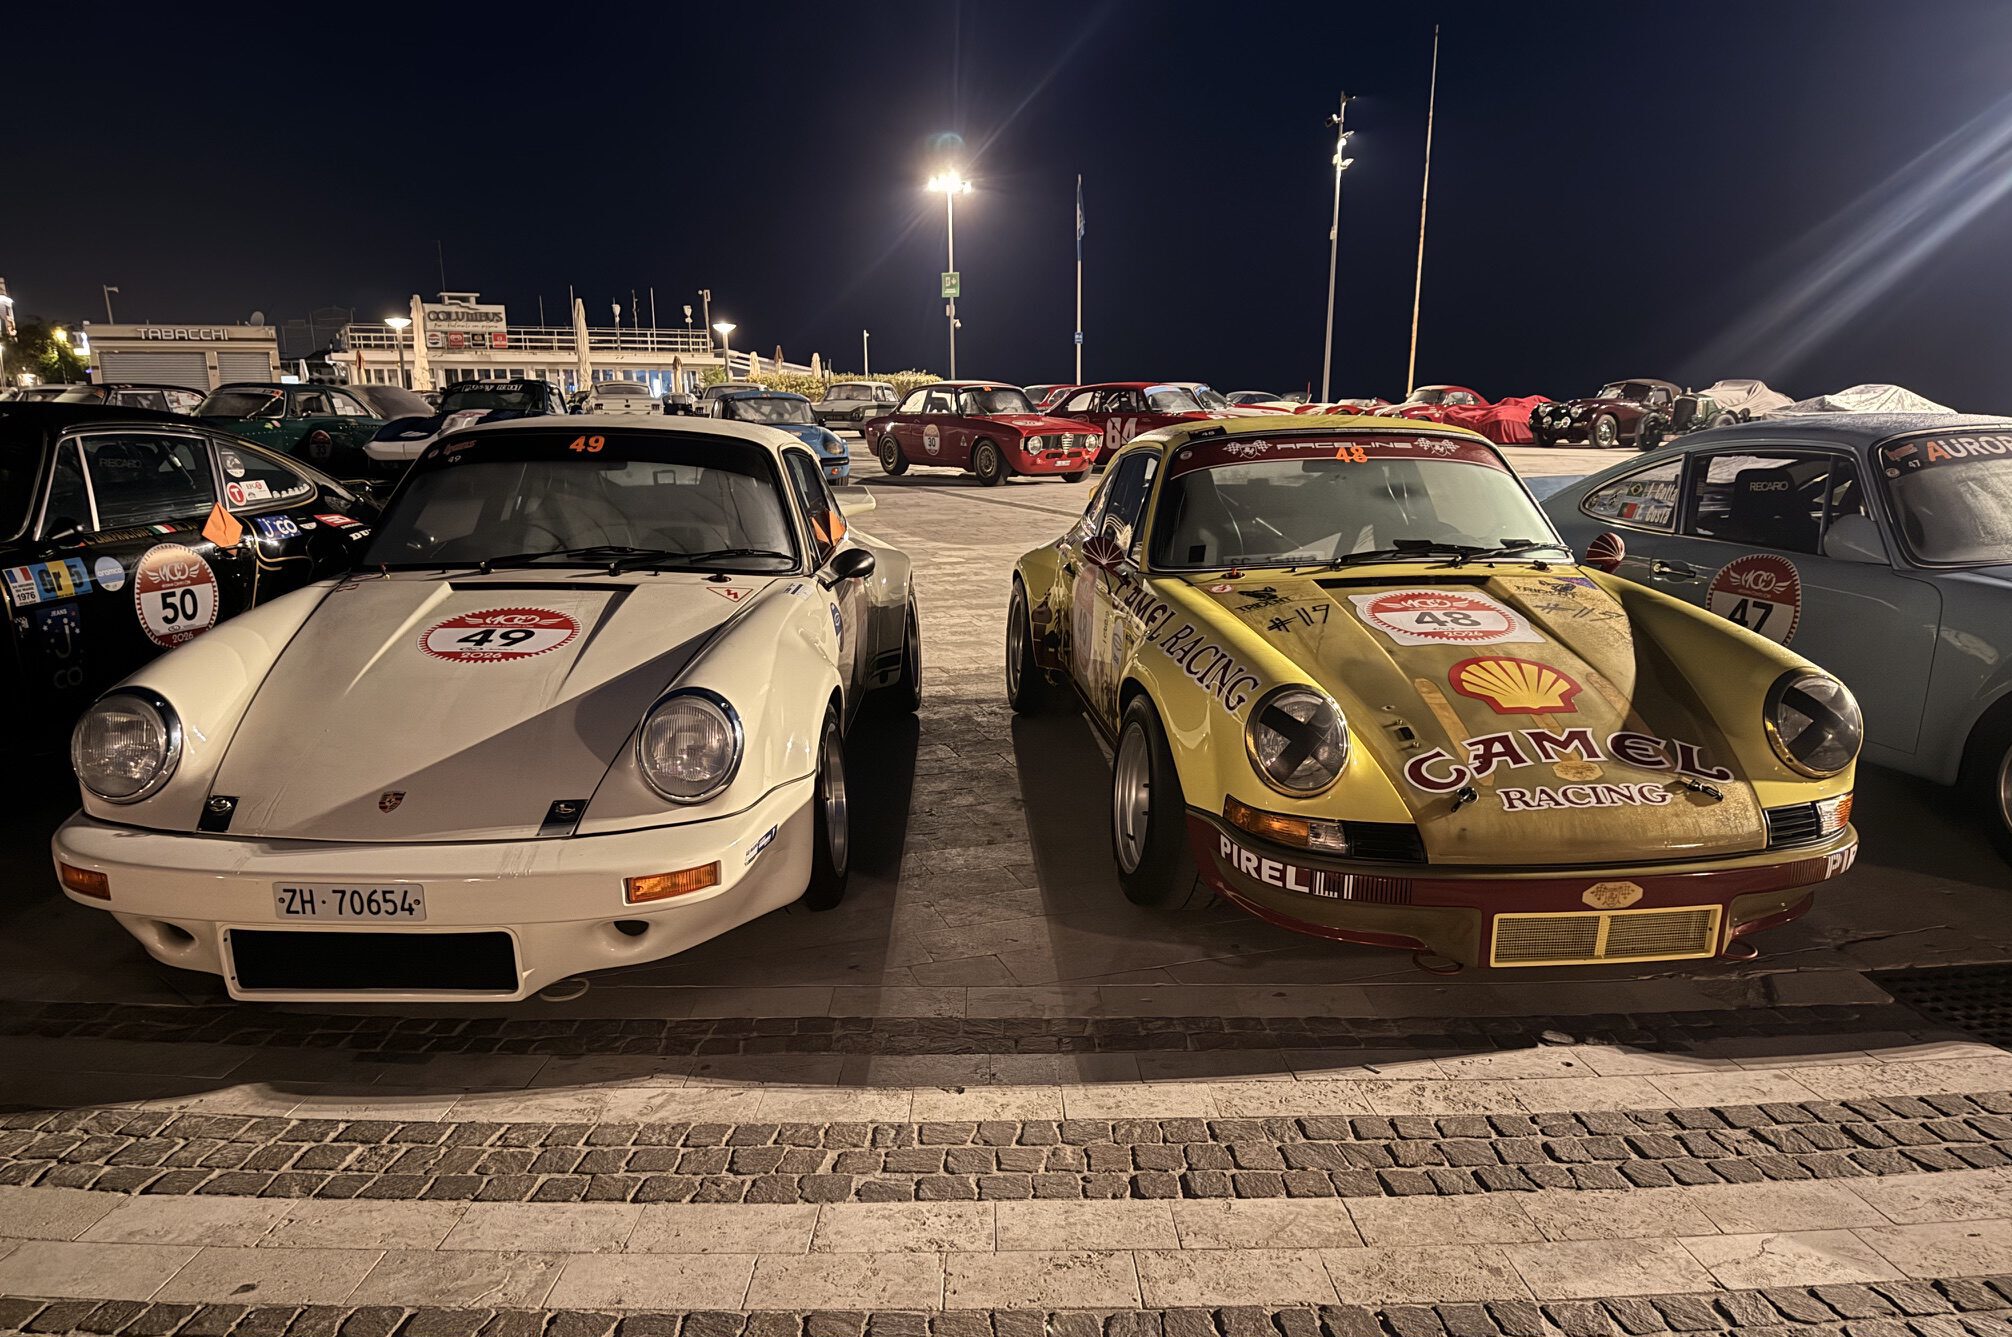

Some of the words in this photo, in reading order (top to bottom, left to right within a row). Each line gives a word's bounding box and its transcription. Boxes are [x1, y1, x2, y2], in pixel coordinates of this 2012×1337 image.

[428, 310, 503, 322] COLUMBUS
[136, 327, 230, 342] TABACCHI
[569, 435, 605, 453] 49
[1335, 446, 1368, 463] 48
[1750, 481, 1789, 492] RECARO
[97, 567, 123, 577] aramco
[17, 591, 36, 601] 1976
[50, 608, 68, 617] JEANS
[161, 588, 198, 624] 50
[1415, 611, 1481, 627] 48
[1728, 598, 1774, 633] 47
[172, 631, 194, 643] 2026
[456, 629, 536, 647] 49
[1113, 577, 1178, 642] CAMEL
[1158, 624, 1261, 713] RACING
[1404, 727, 1735, 793] CAMEL
[1496, 783, 1674, 812] RACING
